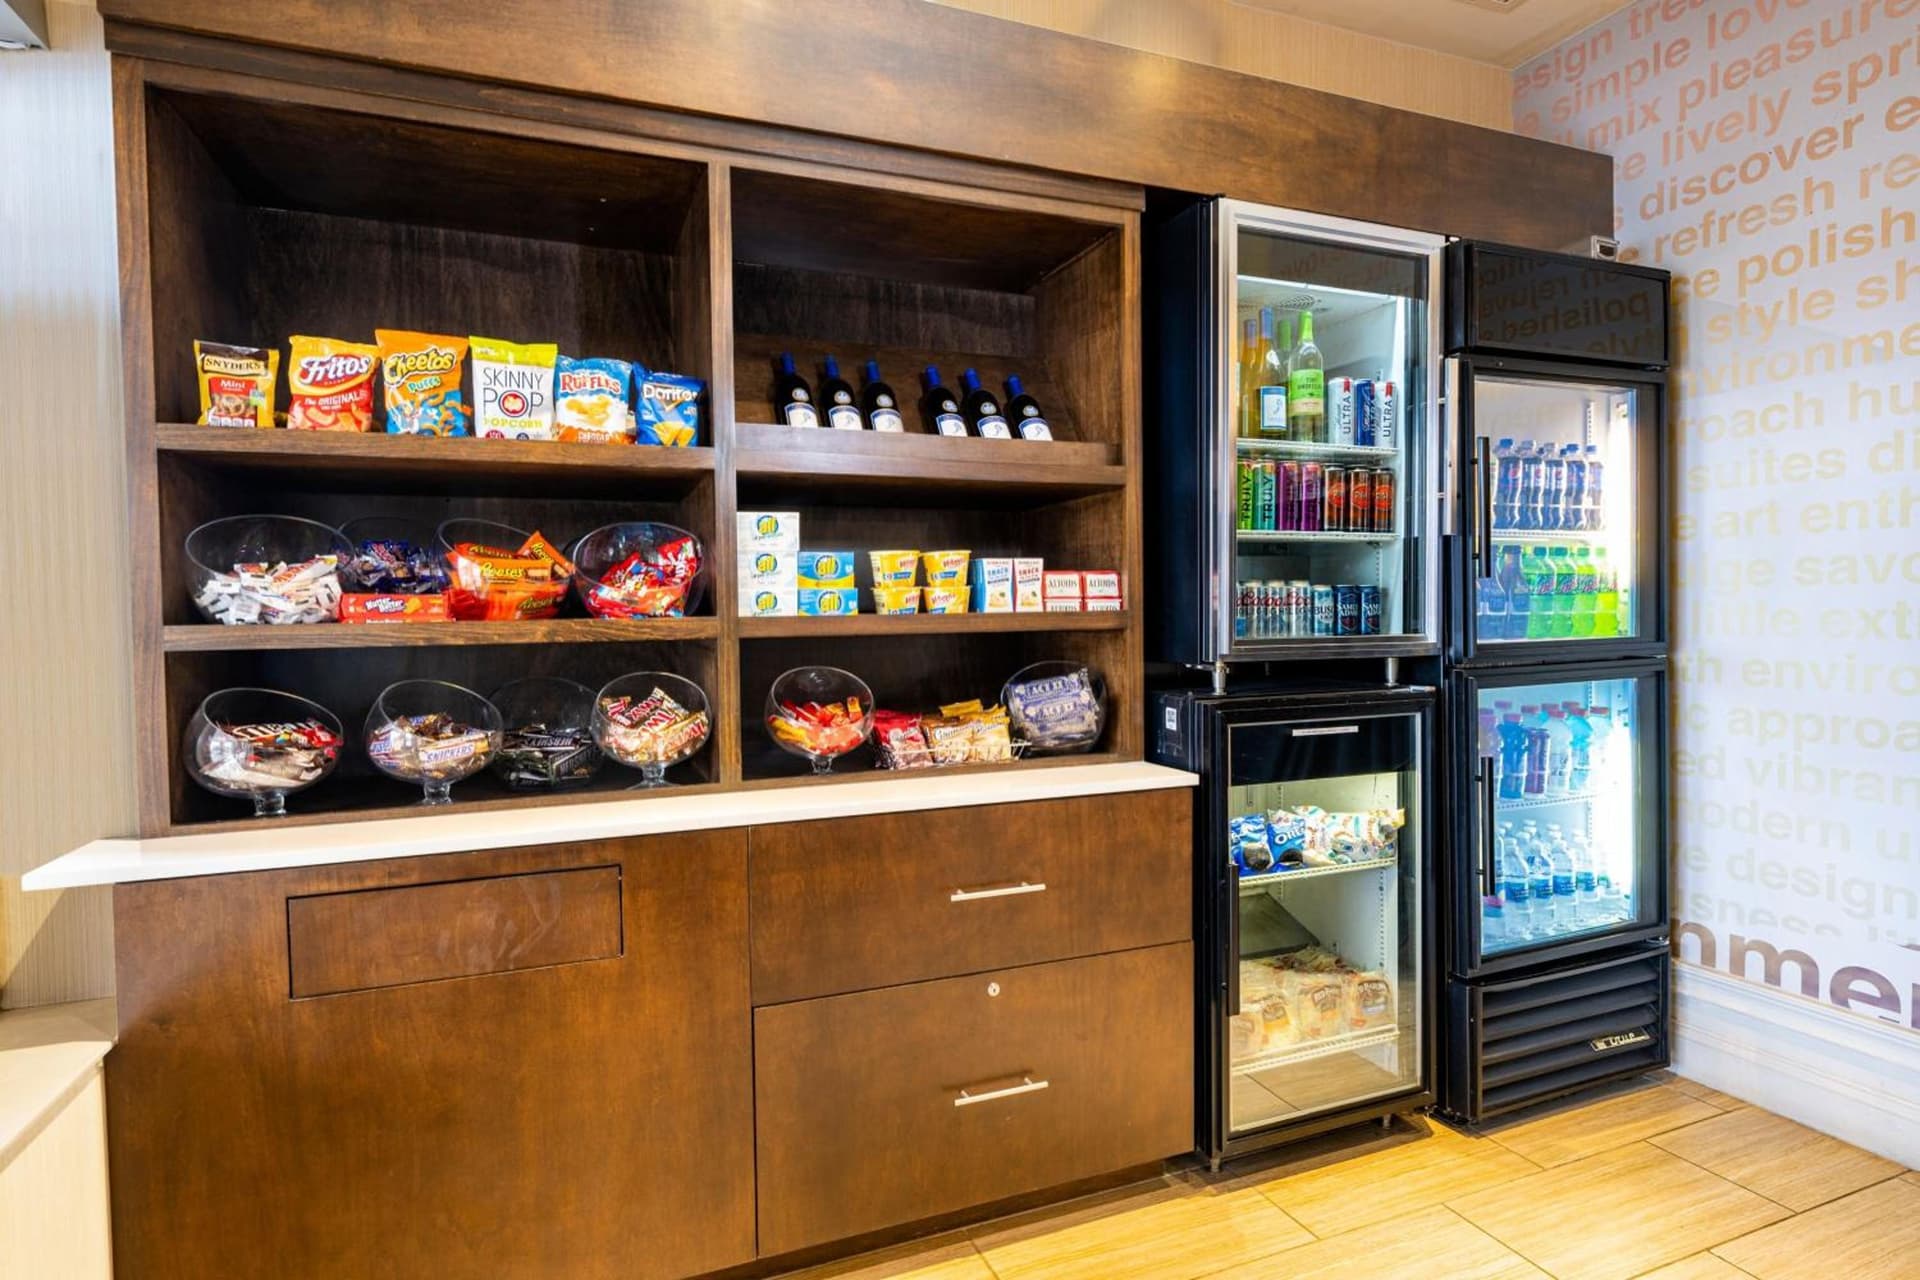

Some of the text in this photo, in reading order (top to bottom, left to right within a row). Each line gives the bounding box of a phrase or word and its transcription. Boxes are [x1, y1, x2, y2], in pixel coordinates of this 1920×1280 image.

[1551, 37, 1691, 124] simple
[1587, 96, 1662, 150] mix
[1662, 88, 1791, 167] lively
[1639, 113, 1865, 221] discover
[1653, 177, 1835, 263] refresh
[1738, 207, 1915, 298] polish
[1706, 287, 1835, 344] style
[299, 354, 371, 385] Fritos
[385, 349, 455, 382] Cheetos
[407, 376, 441, 393] Puffs
[483, 367, 545, 389] SKINNY
[560, 373, 621, 393] RUFFLES
[483, 387, 544, 417] POP
[1342, 395, 1352, 435] ULTRA
[1383, 399, 1393, 438] ULTRA
[1687, 446, 1847, 494] suites
[1242, 476, 1252, 521] TRULY
[1263, 476, 1274, 522] TRULY
[759, 516, 776, 536] all
[1712, 499, 1782, 540] art
[816, 556, 836, 577] all
[819, 594, 838, 613] all
[1692, 600, 1800, 640] little
[427, 744, 473, 762] SNICKERS
[1726, 846, 1917, 920] design
